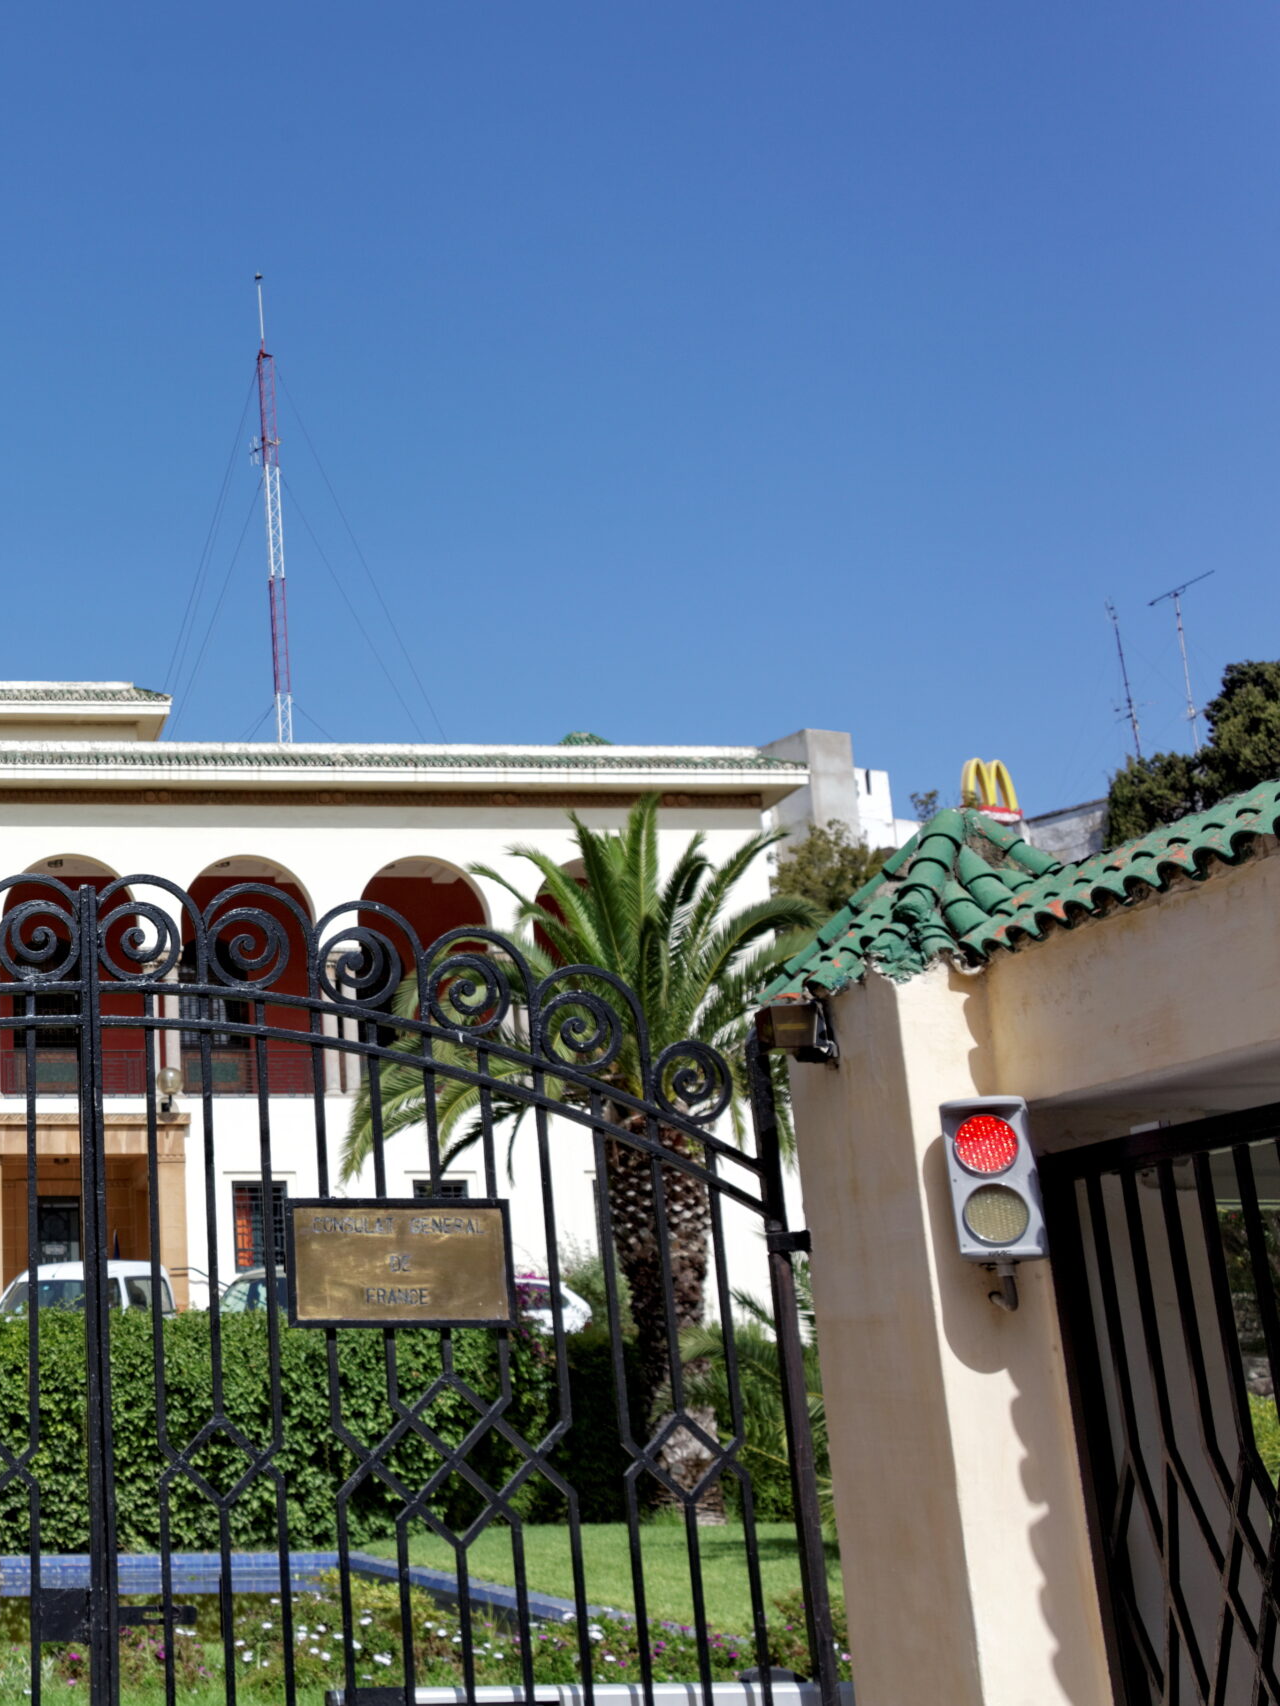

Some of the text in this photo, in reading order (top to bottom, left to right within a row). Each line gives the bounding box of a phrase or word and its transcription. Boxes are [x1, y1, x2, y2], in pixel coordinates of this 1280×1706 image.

[312, 1217, 487, 1234] CONSULAT GENERAL
[390, 1255, 412, 1272] DE
[366, 1287, 430, 1305] FRANCE
